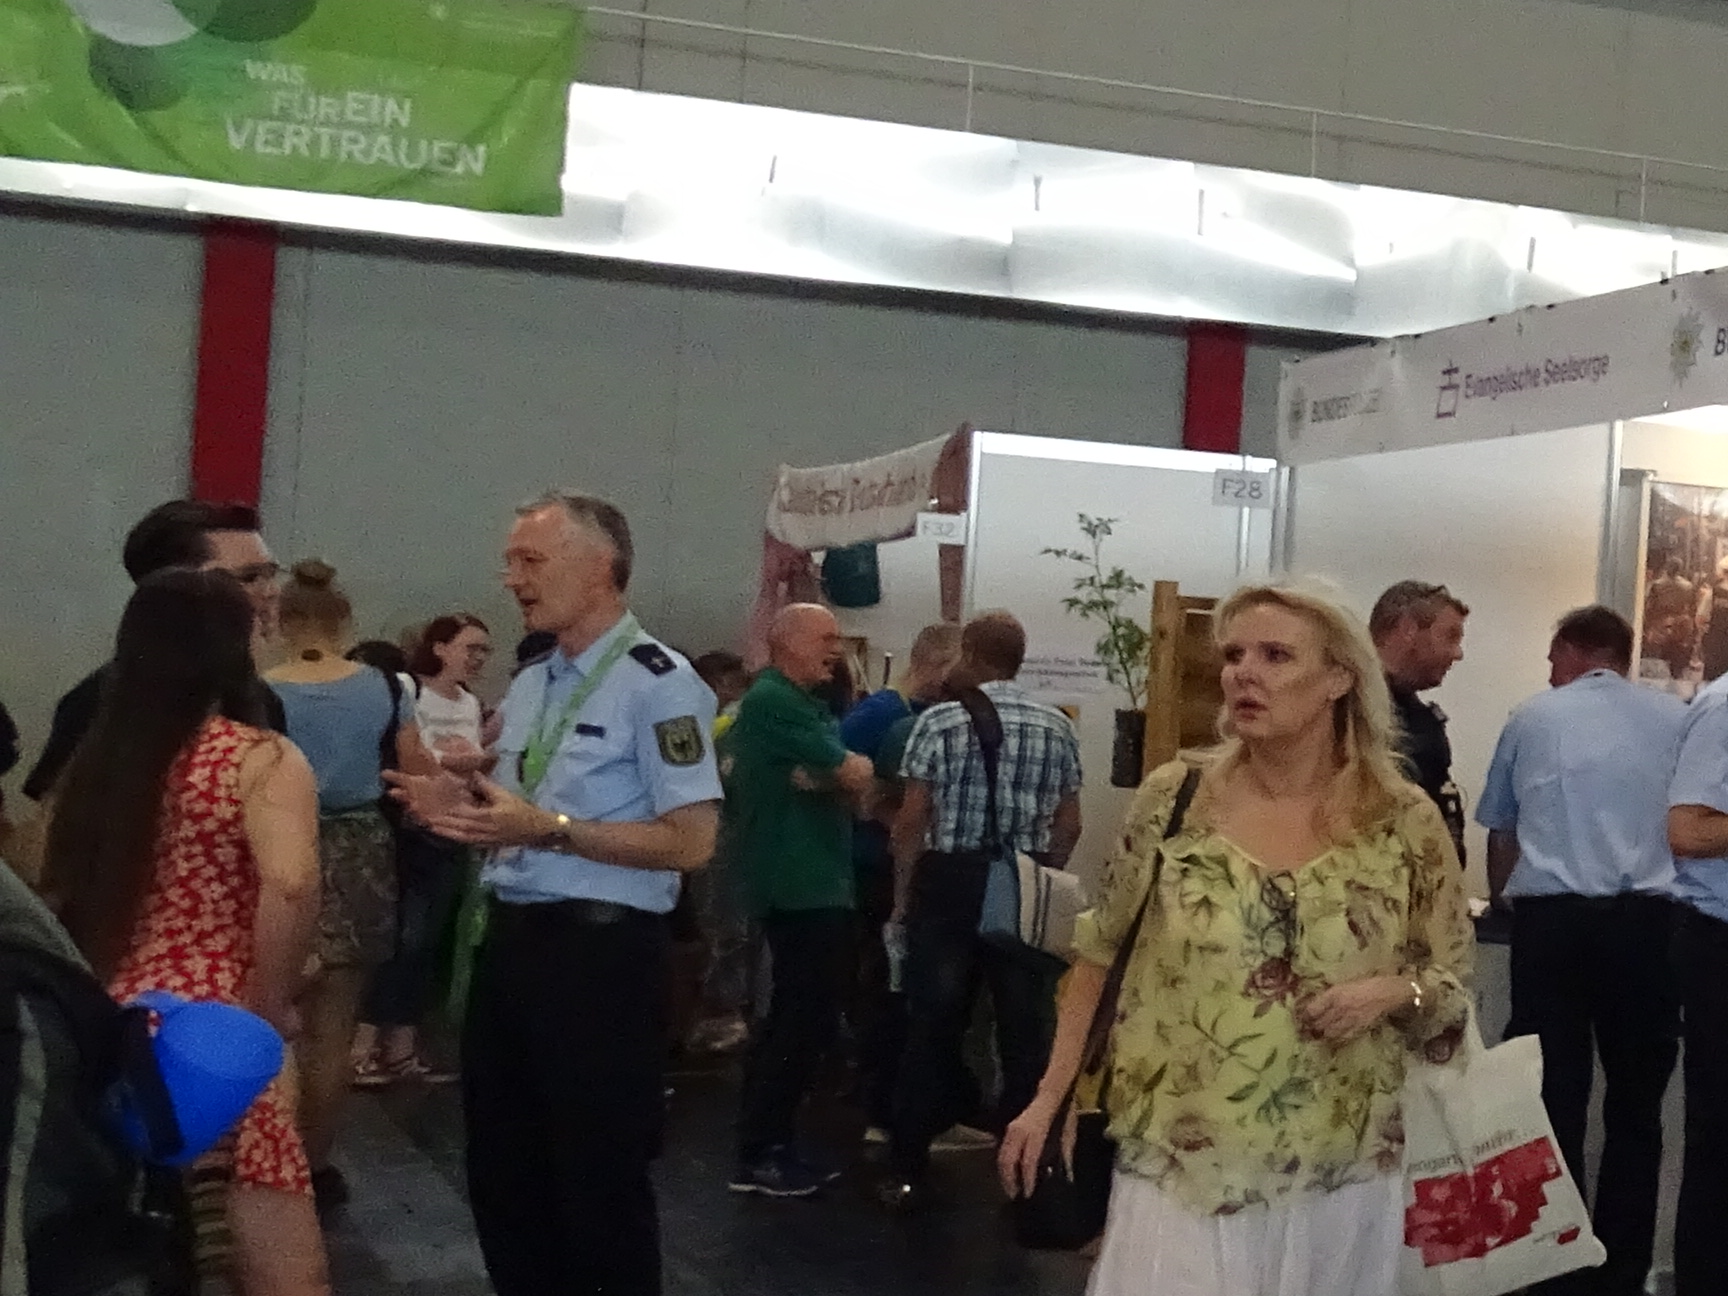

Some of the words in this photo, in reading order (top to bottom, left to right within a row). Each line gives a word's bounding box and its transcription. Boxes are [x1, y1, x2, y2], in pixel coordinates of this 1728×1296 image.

[246, 58, 307, 85] WAS
[345, 91, 412, 128] EIN
[225, 113, 488, 176] VERTRAUEN
[1464, 365, 1540, 401] Evangelische
[1545, 354, 1611, 388] Seelsorge
[1221, 478, 1263, 501] F28
